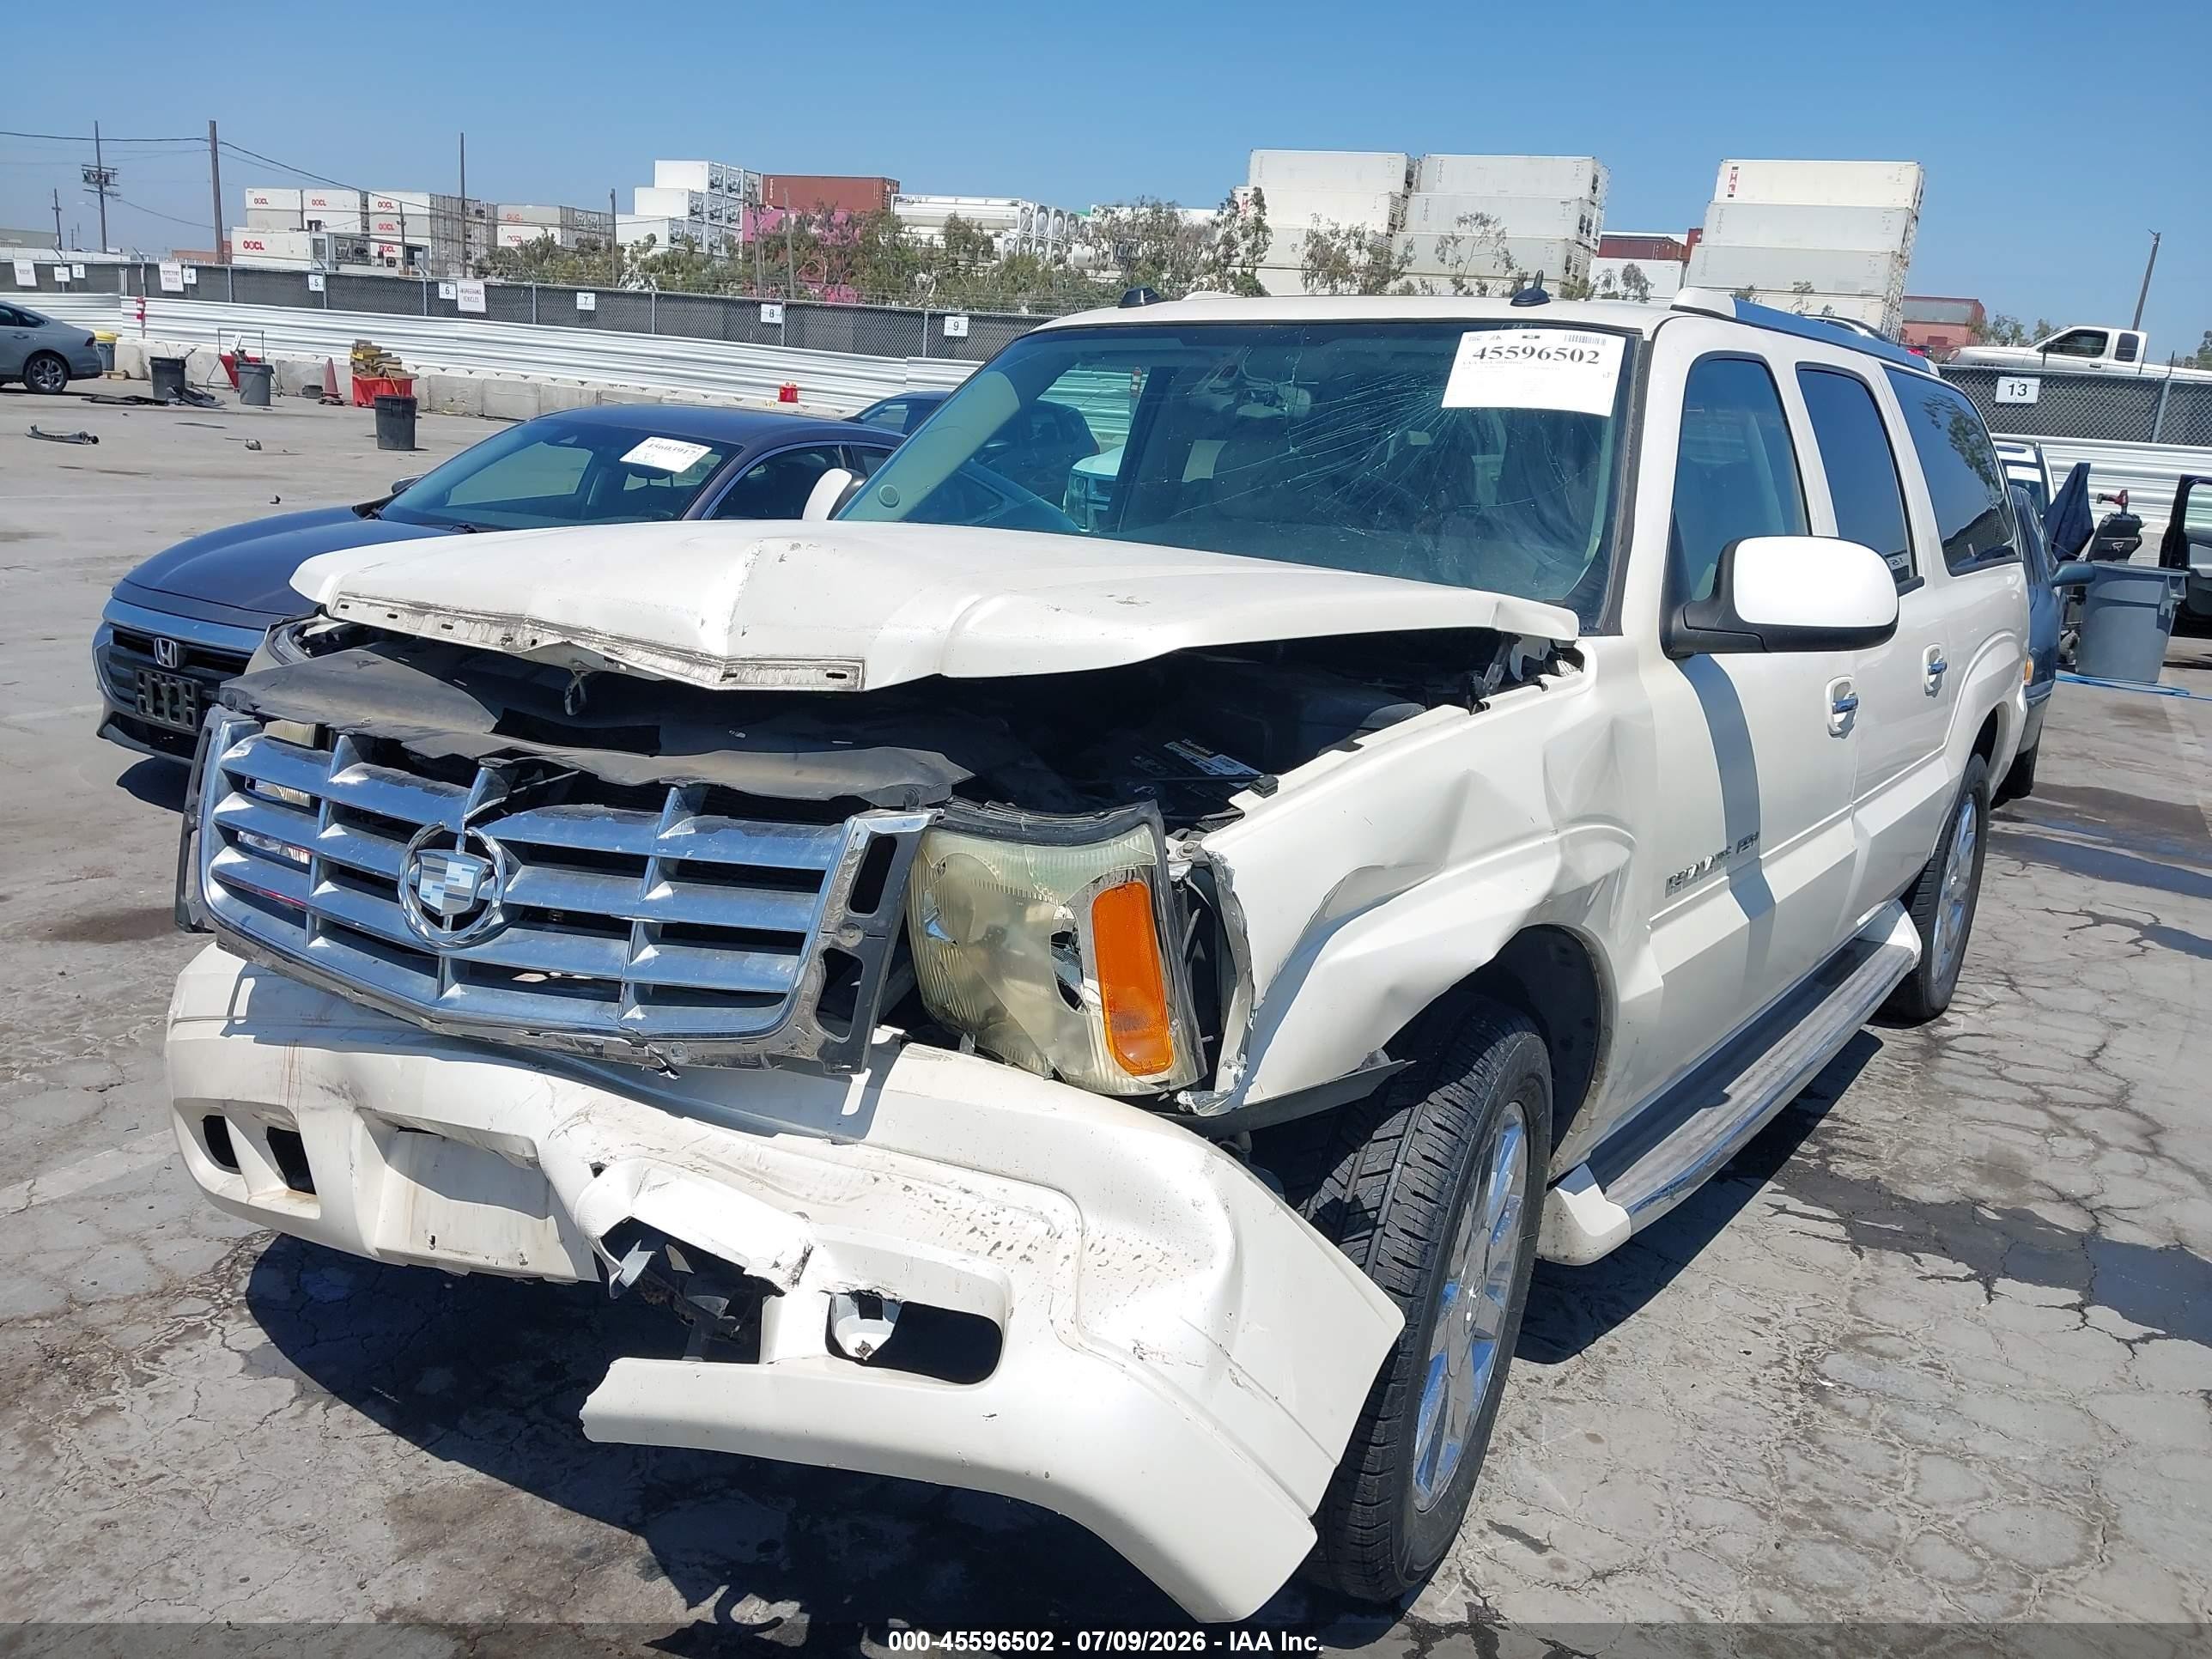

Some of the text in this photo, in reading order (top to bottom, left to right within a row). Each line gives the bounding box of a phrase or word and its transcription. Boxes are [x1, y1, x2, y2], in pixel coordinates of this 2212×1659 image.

[379, 222, 395, 231] OOCL
[243, 240, 264, 250] OOCL
[314, 278, 319, 287] 5
[445, 286, 450, 295] 6
[583, 296, 588, 305] 7
[769, 308, 775, 318] 8
[953, 321, 959, 331] 9
[1472, 345, 1601, 365] 45596502
[2008, 383, 2028, 397] 13
